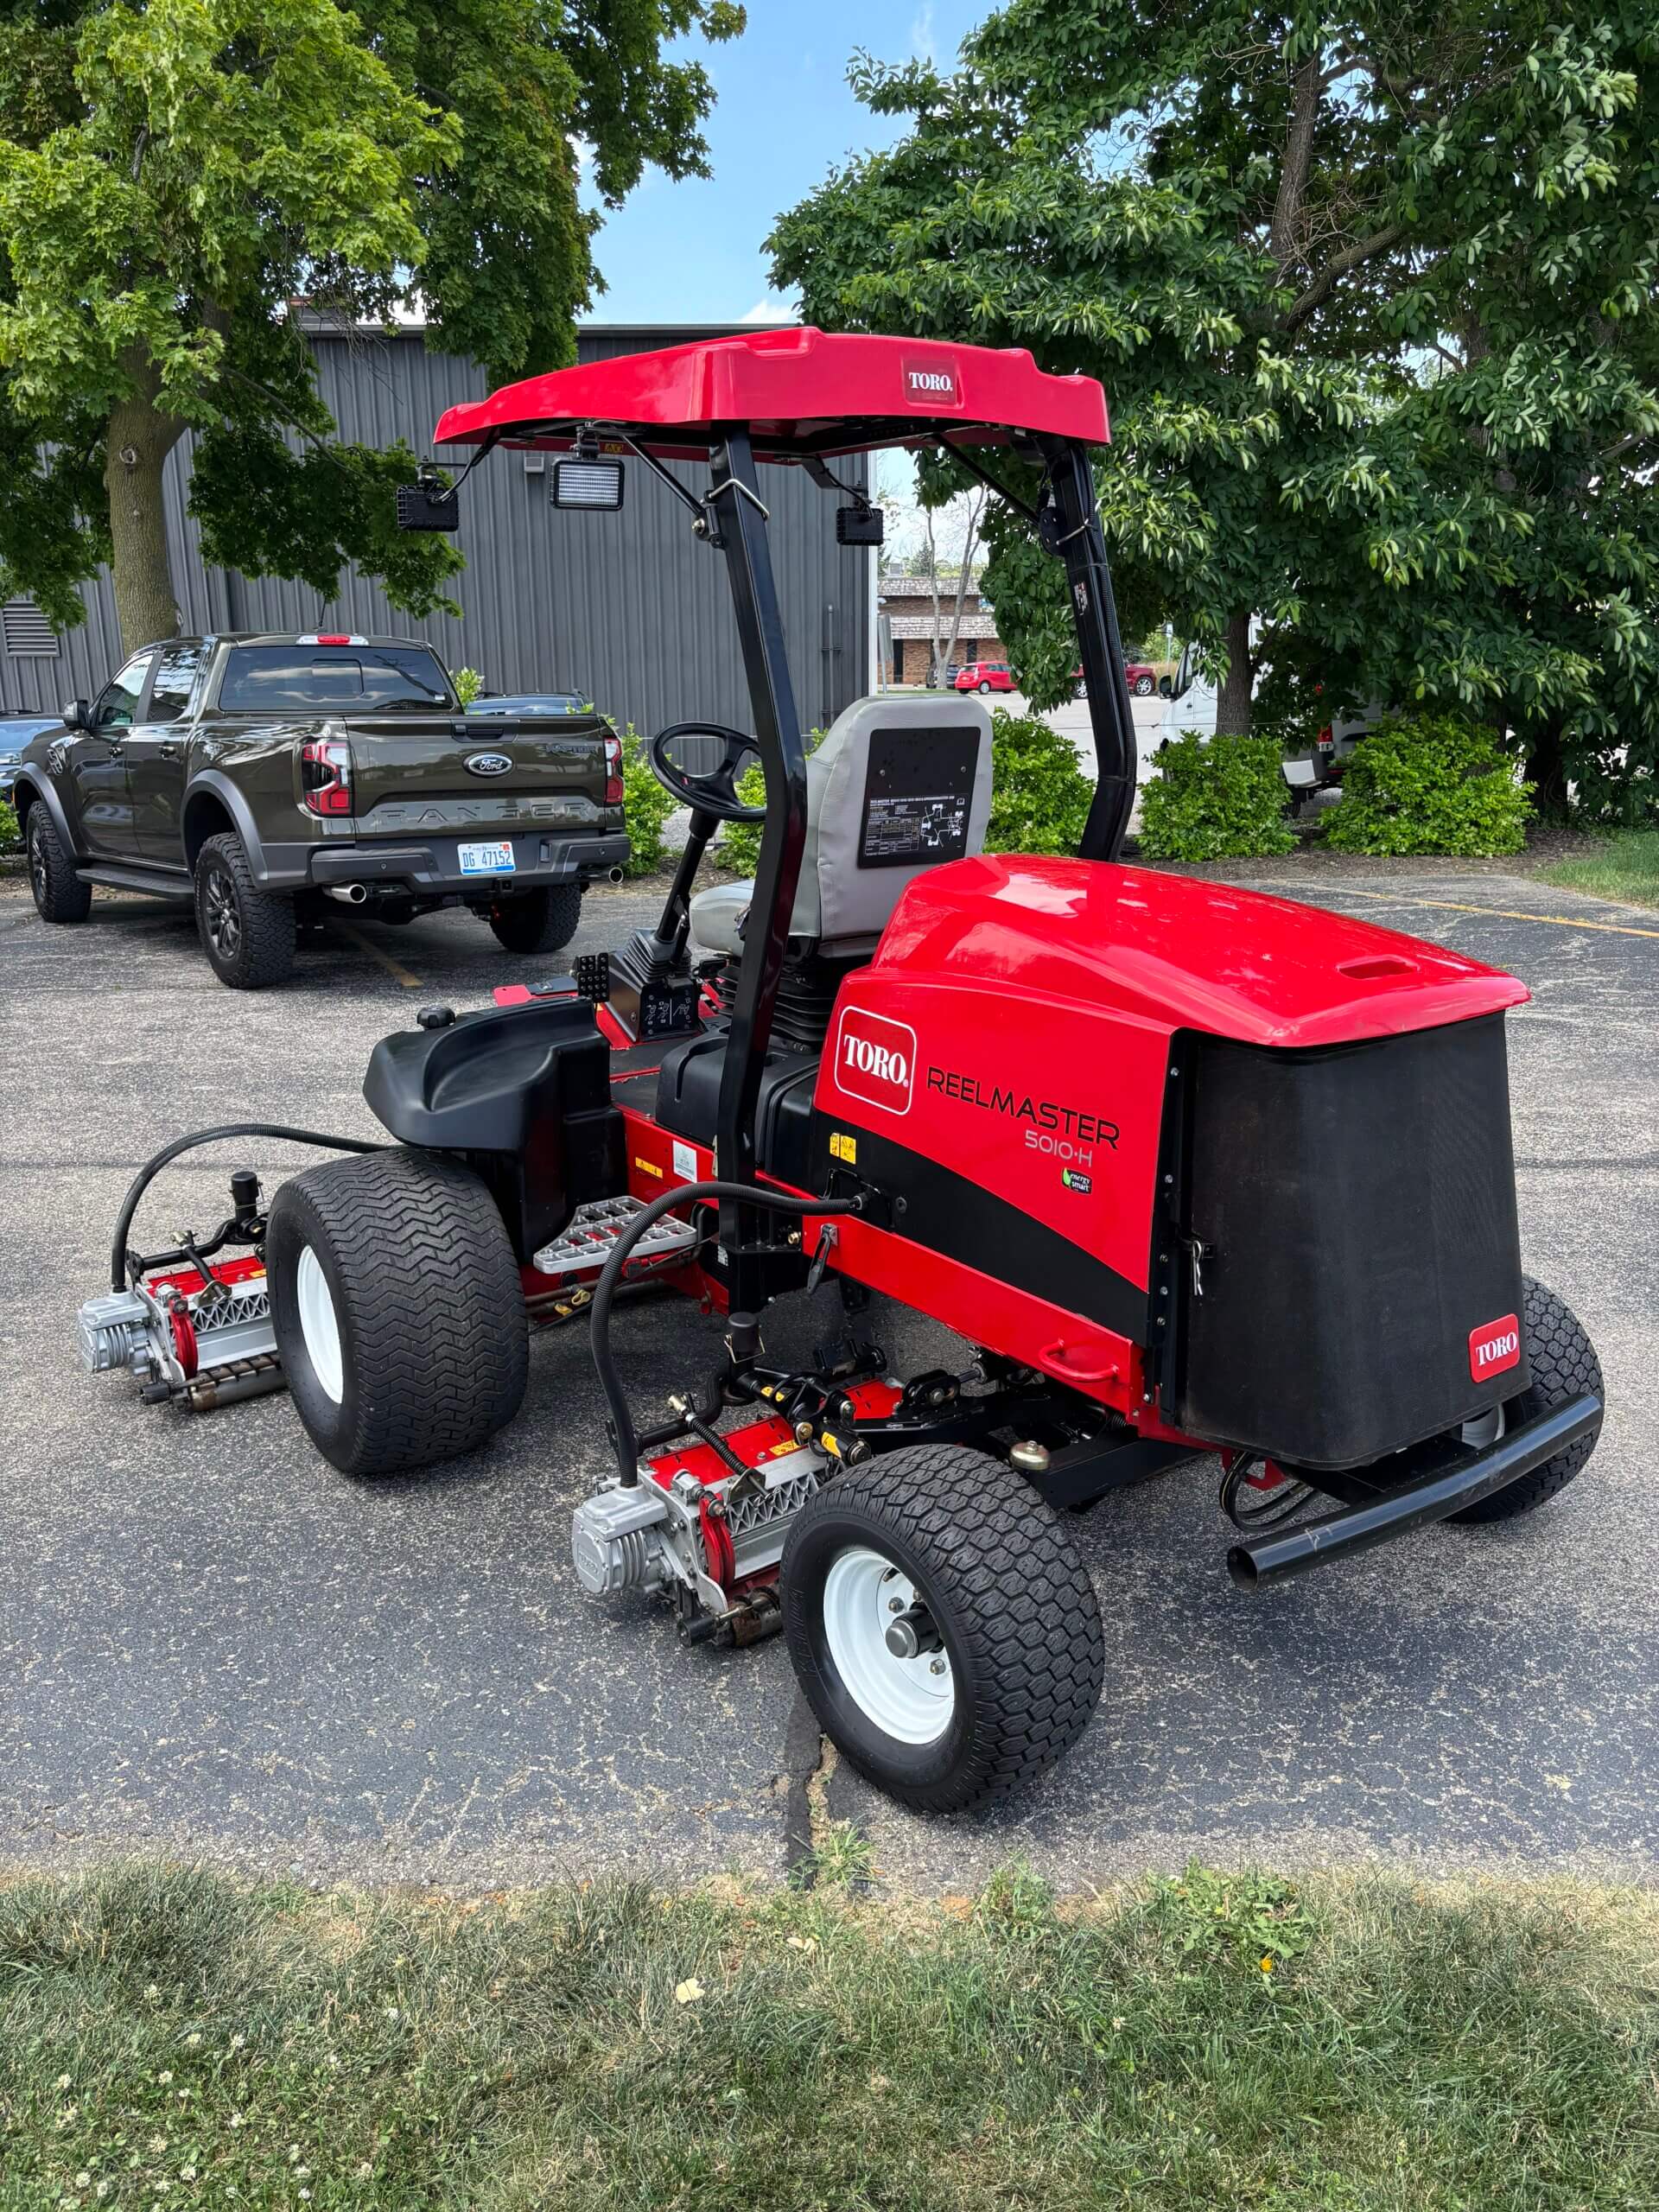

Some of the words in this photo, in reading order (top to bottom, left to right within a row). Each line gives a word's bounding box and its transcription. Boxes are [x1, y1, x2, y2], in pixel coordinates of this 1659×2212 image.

[480, 758, 503, 770] Ford
[462, 852, 475, 868] DG
[482, 850, 512, 866] 47152
[926, 1066, 1121, 1151] REELMASTER
[1070, 1173, 1090, 1185] energy
[1071, 1181, 1090, 1192] smart
[1475, 1332, 1517, 1366] TORO
